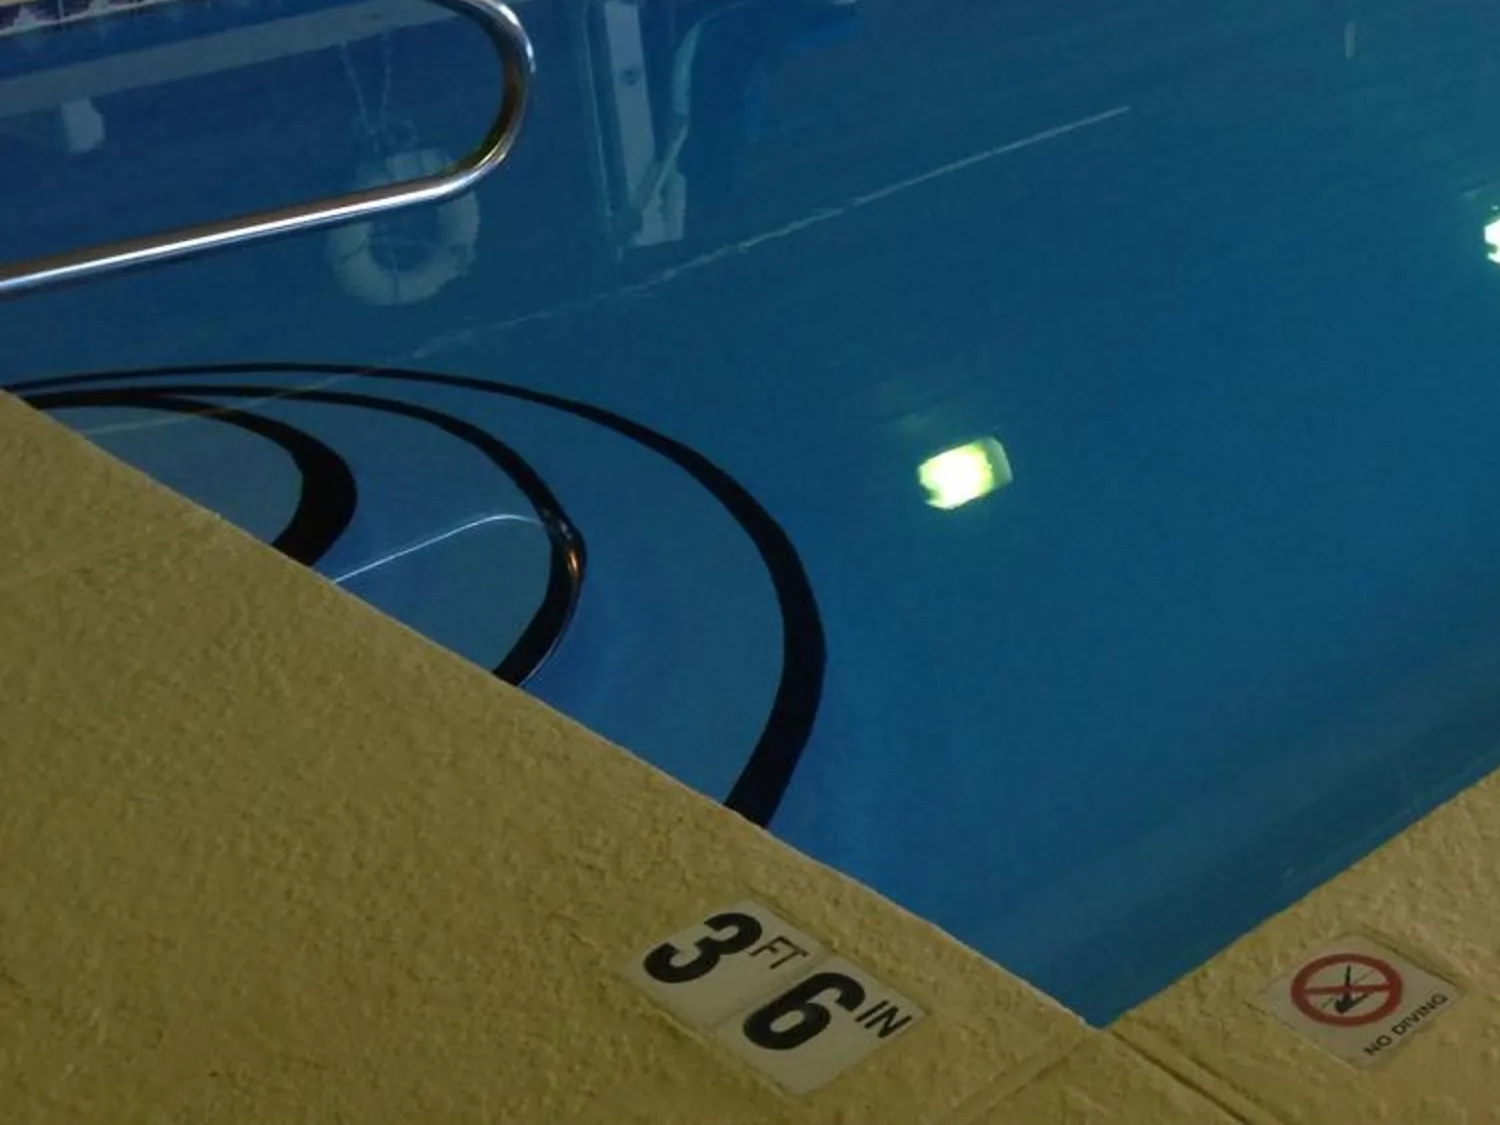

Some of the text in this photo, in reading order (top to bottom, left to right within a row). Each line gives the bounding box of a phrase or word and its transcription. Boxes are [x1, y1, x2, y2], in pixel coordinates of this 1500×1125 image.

[643, 912, 809, 984] 3 FT
[742, 971, 912, 1051] 6 IN
[1363, 992, 1449, 1057] NO DIVING
